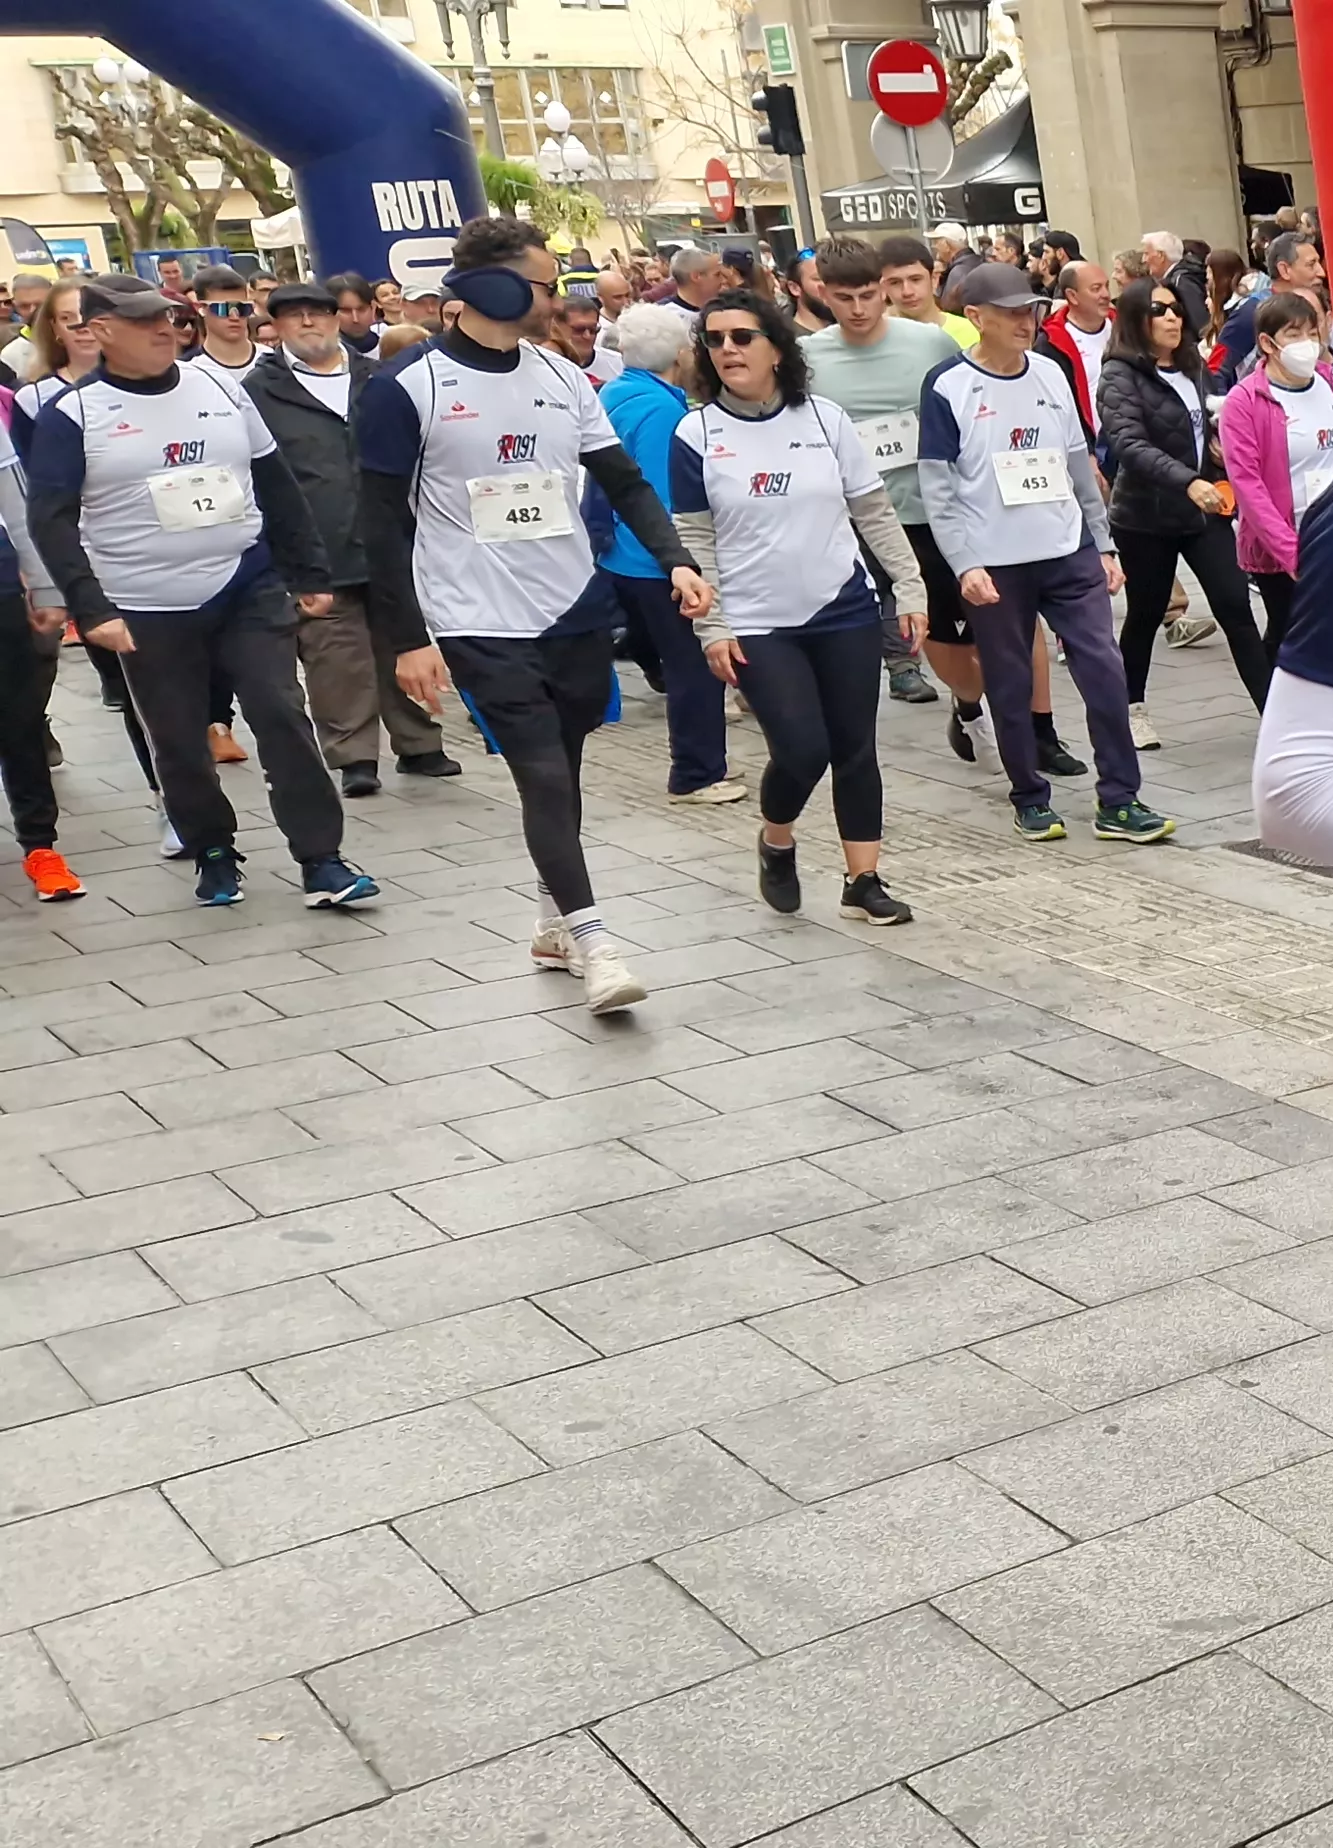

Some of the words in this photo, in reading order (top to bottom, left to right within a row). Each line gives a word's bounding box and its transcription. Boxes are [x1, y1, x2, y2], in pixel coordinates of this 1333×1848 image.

[371, 179, 462, 232] RUTA
[839, 195, 882, 222] GED
[1014, 187, 1041, 215] G
[875, 441, 904, 459] 428
[1022, 476, 1048, 490] 453
[192, 497, 216, 513] 12
[506, 506, 542, 525] 482
